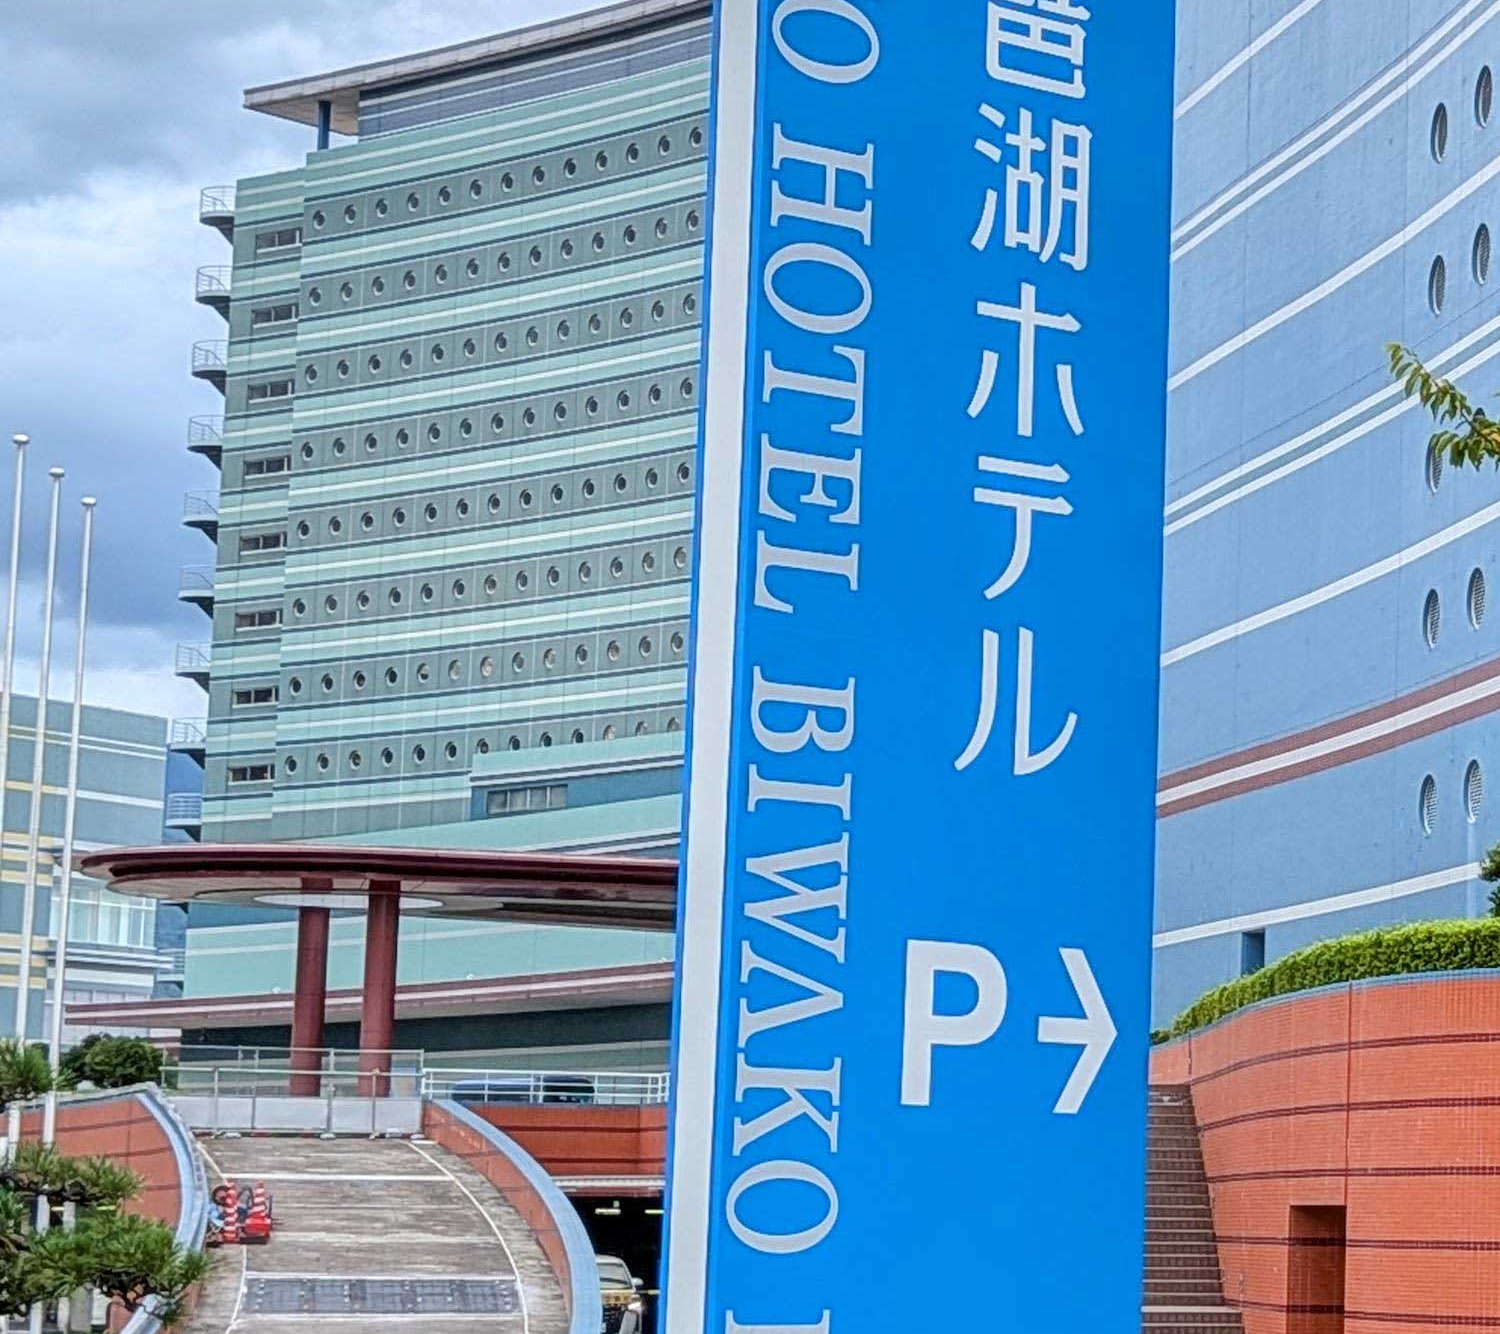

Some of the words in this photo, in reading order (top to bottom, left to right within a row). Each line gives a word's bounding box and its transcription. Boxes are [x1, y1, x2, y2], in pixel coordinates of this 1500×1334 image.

[752, 123, 874, 614] HOTEL
[725, 665, 856, 1255] BIWAKO
[902, 938, 1008, 1106] P
